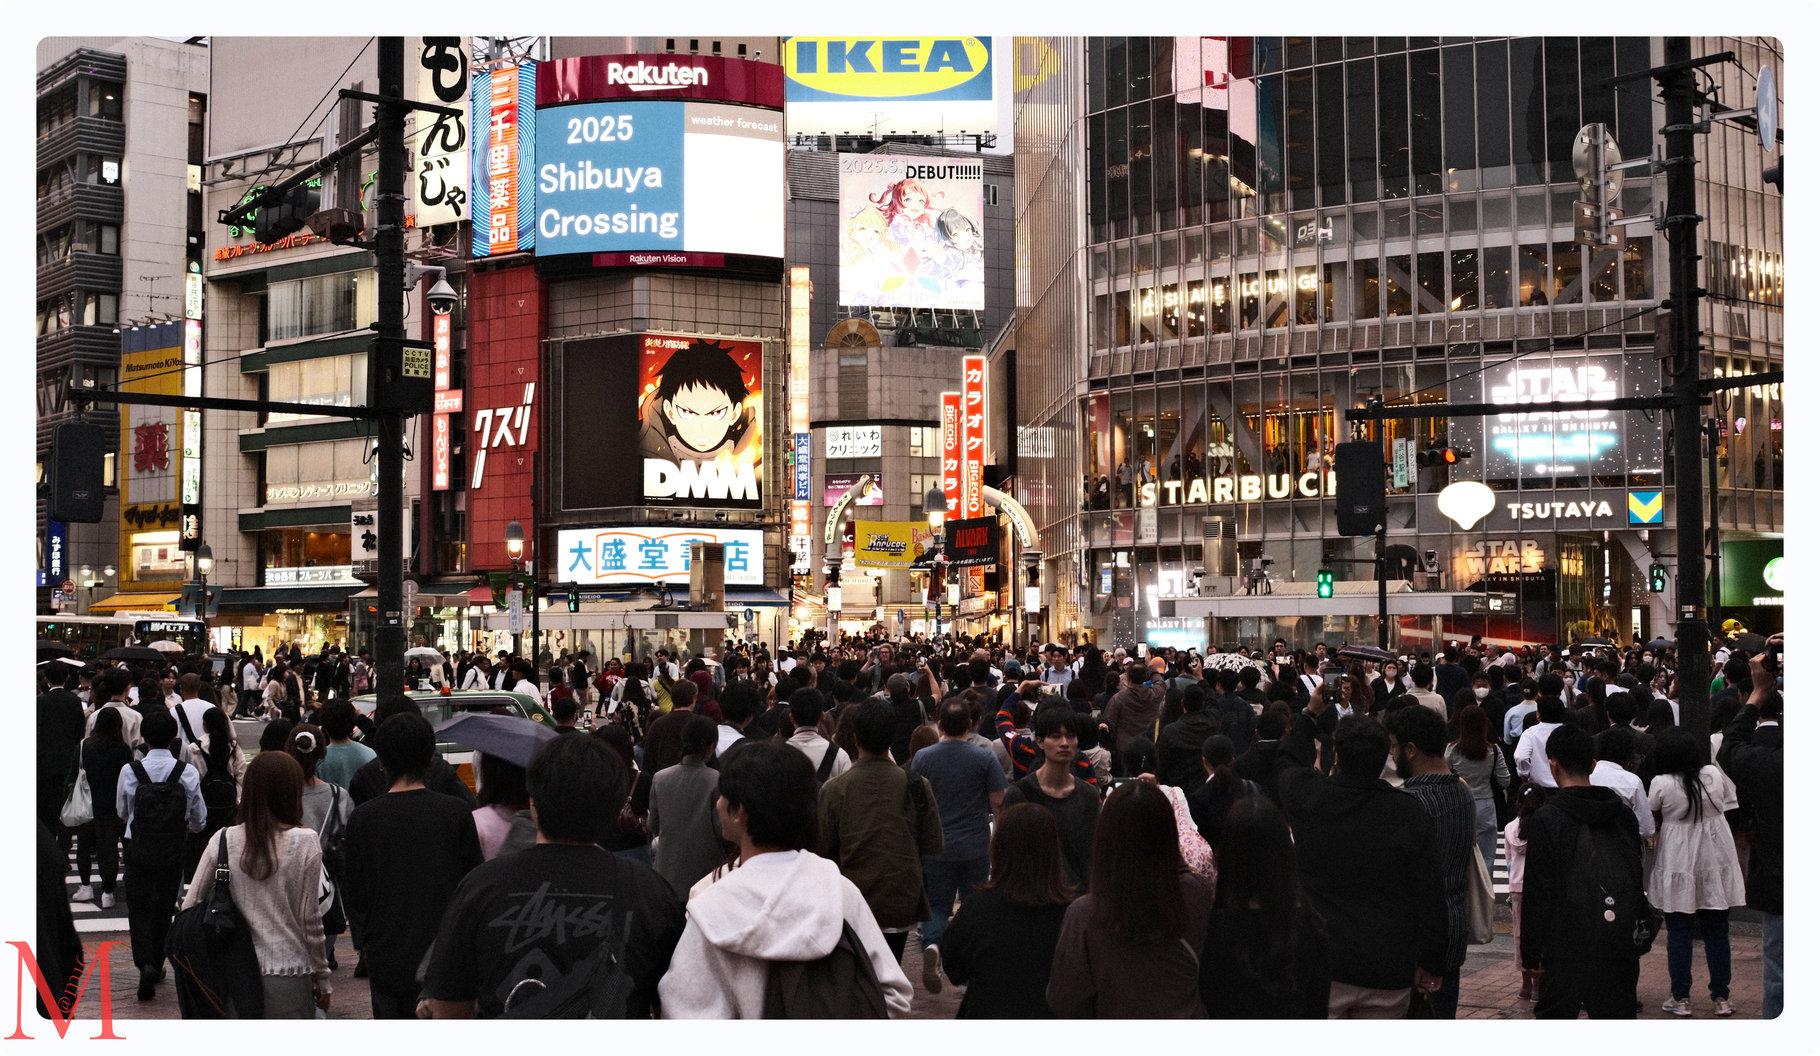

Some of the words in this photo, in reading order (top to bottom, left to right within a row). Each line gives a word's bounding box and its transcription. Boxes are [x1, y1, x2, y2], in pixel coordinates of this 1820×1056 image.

[796, 39, 975, 74] IKEA
[607, 60, 709, 92] Rakuten
[420, 37, 467, 217] もんじゃ
[567, 114, 634, 145] 2025
[691, 116, 735, 128] weather
[737, 117, 779, 133] forecast
[488, 75, 512, 244] 三千里薬品
[540, 160, 663, 194] Shibuya
[540, 204, 680, 239] Crossing
[629, 254, 662, 264] Rakuten
[663, 254, 687, 263] Vision
[126, 360, 165, 373] Matsumoto
[404, 350, 430, 358] CCTV
[404, 362, 429, 370] POLICE
[1492, 366, 1617, 396] STAR
[966, 368, 983, 451] カラオケ
[134, 421, 170, 474] 薬
[471, 382, 536, 489] クスリ
[841, 430, 880, 442] れいわ
[643, 458, 760, 500] DMM
[944, 458, 959, 521] カラオ
[1507, 500, 1614, 520] TSUTAYA
[1465, 539, 1545, 558] STAR
[1465, 556, 1545, 575] WARS
